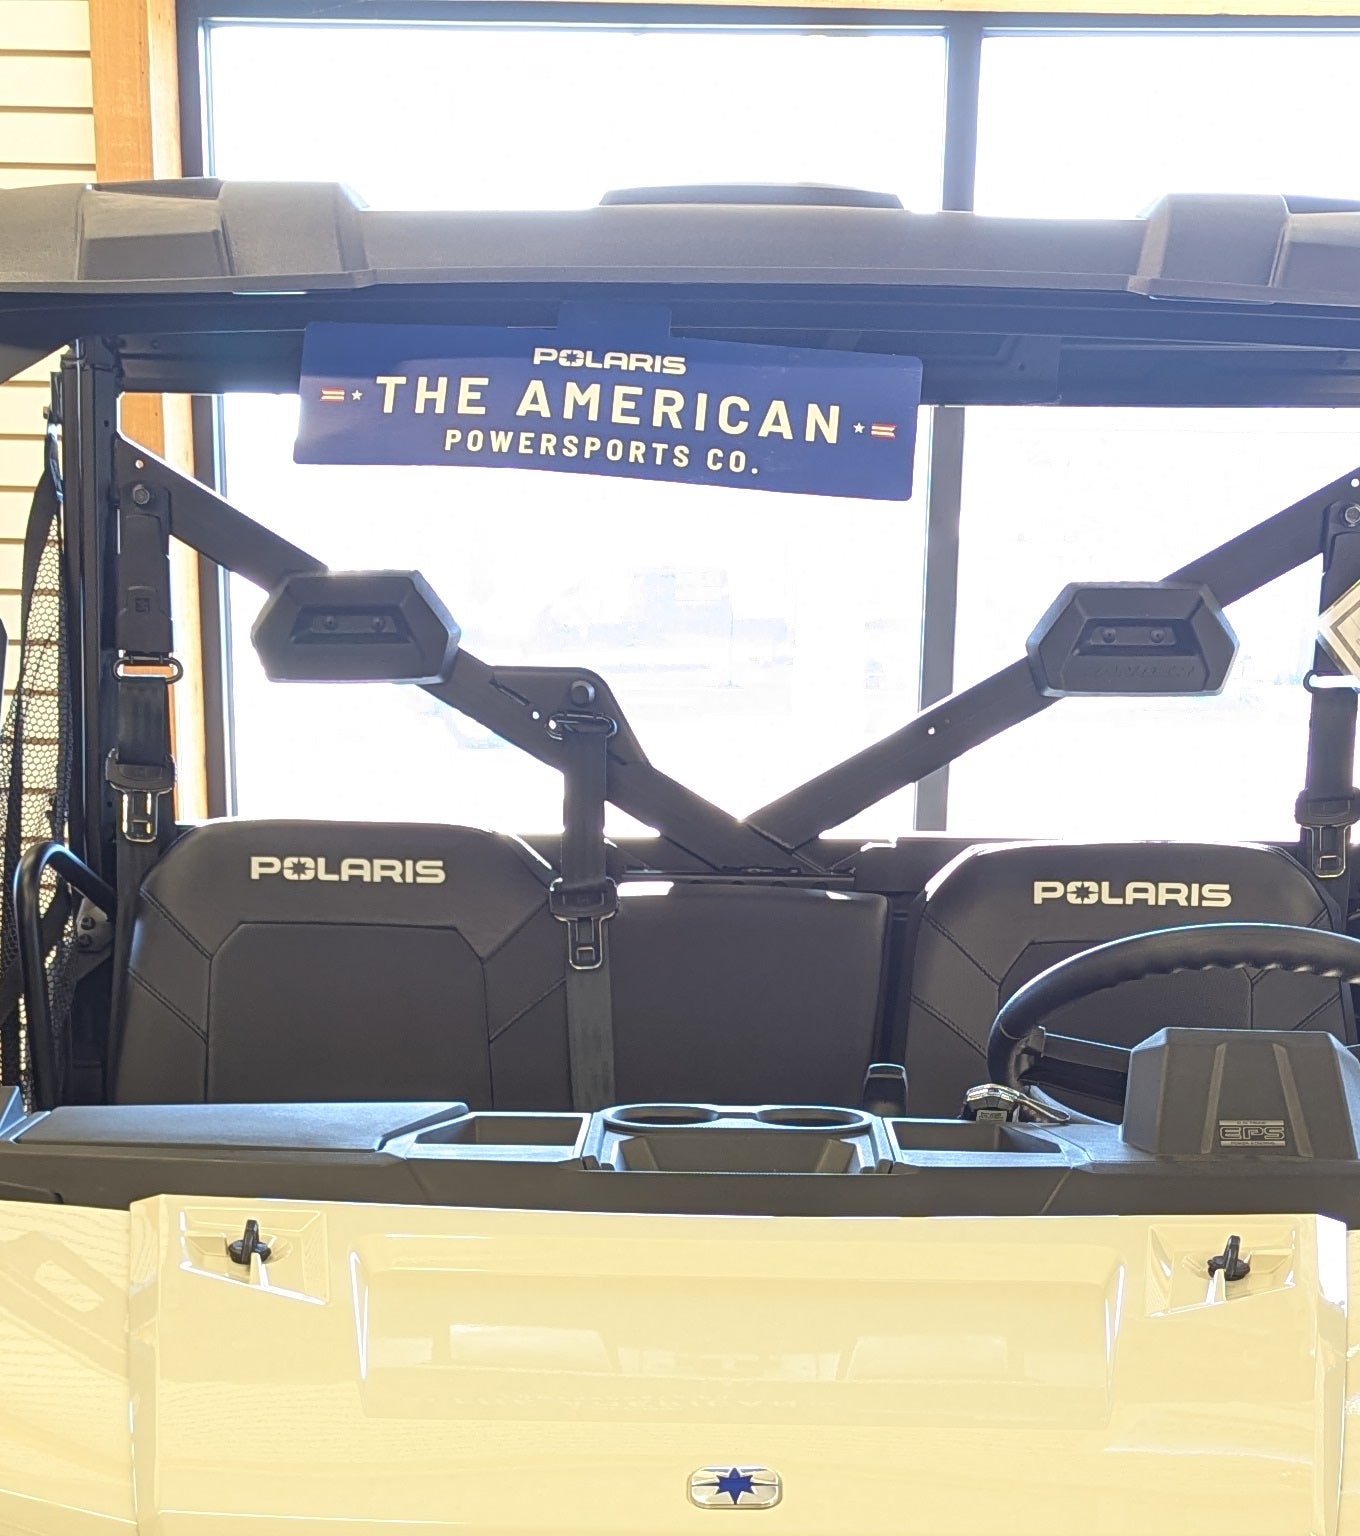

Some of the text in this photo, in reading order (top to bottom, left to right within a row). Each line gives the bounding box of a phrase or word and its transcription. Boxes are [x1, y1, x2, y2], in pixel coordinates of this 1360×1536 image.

[534, 347, 687, 374] POLARIS
[375, 375, 843, 445] THE AMERICAN
[445, 428, 760, 475] POWERSPORTS CO.
[250, 856, 446, 884] POLARIS
[1032, 880, 1232, 907] POLARIS
[1220, 1126, 1285, 1140] EPS
